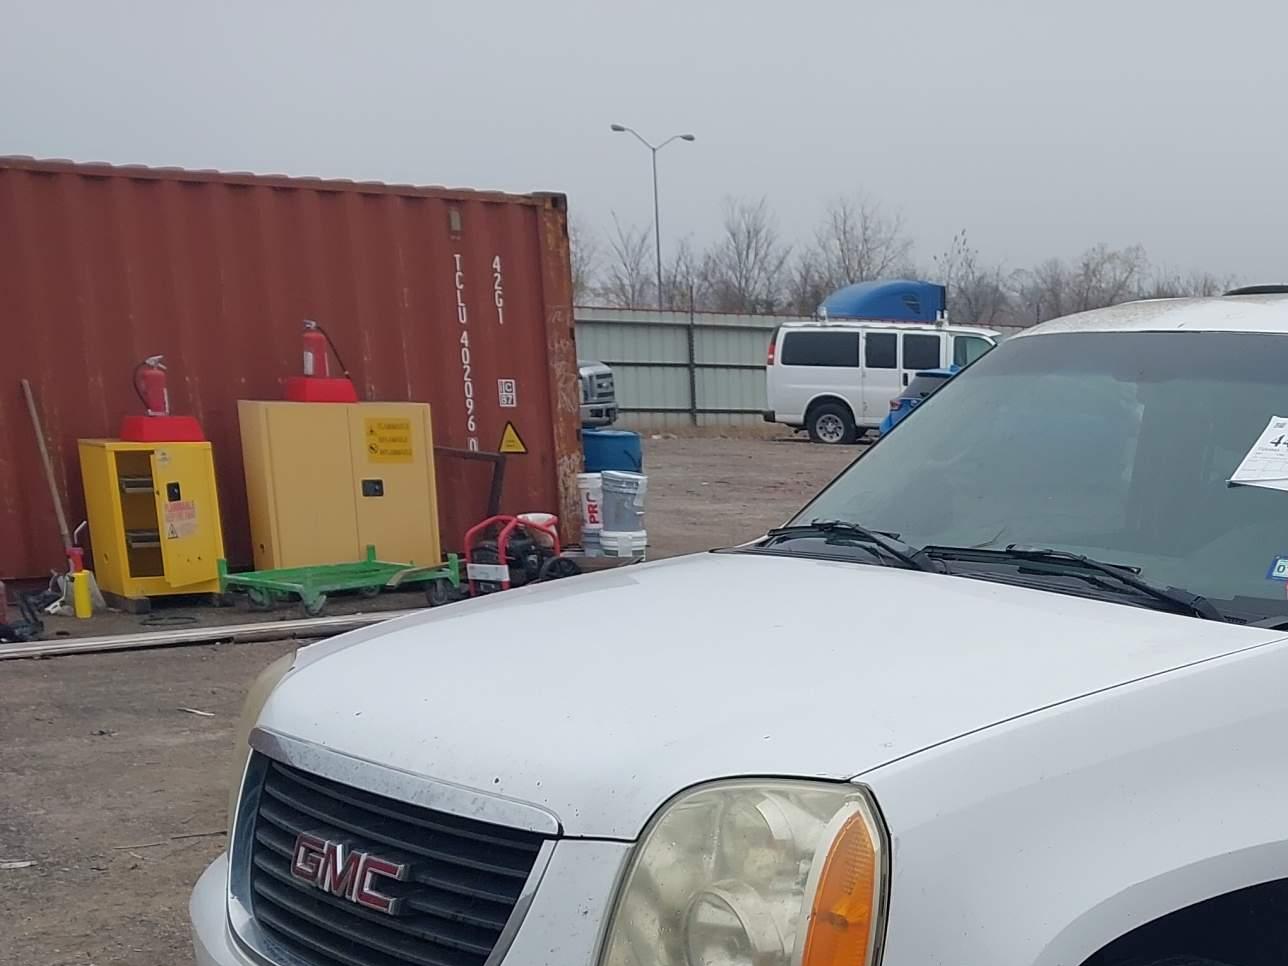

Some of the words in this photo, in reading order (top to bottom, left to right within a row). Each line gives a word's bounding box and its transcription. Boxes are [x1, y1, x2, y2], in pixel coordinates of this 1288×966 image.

[454, 254, 467, 323] TCLU
[492, 255, 503, 325] 42G1
[460, 331, 475, 432] 402096
[291, 832, 404, 915] GMC
